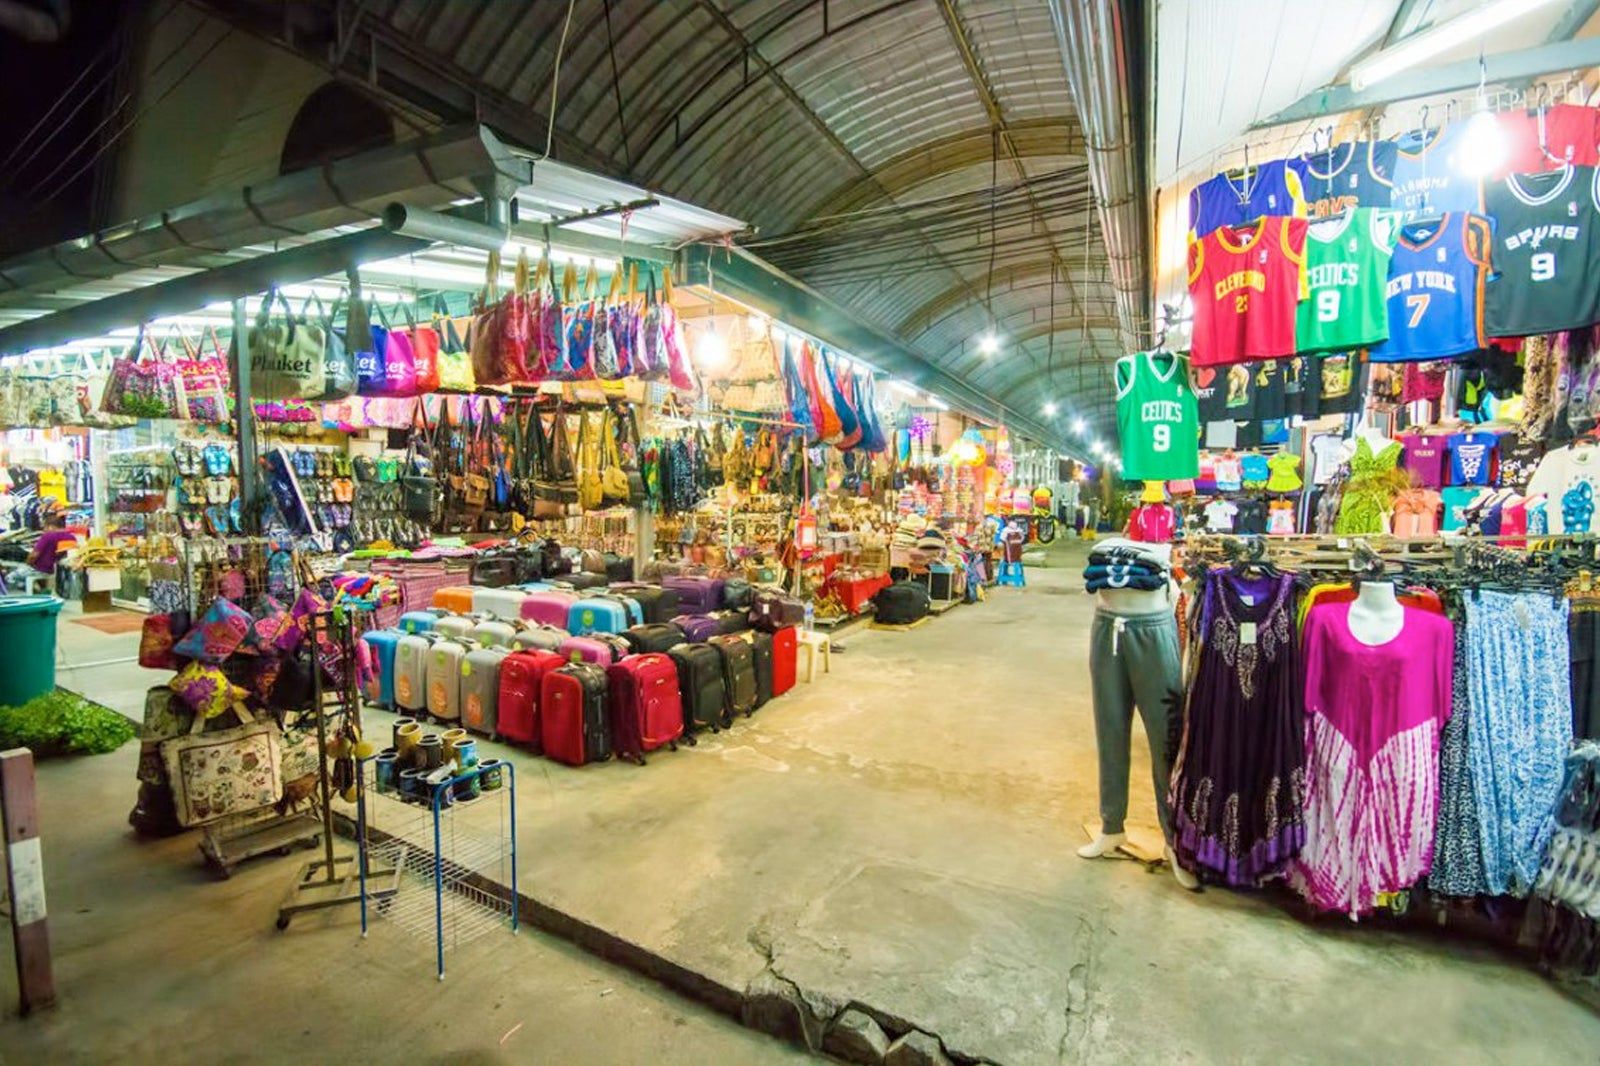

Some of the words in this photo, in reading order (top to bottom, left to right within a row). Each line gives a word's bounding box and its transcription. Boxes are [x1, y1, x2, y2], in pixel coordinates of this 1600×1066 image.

[1505, 225, 1579, 250] SPURS
[1531, 252, 1555, 281] 9
[1416, 271, 1456, 294] YORK
[1317, 289, 1340, 322] 9
[1406, 294, 1430, 328] 7
[1141, 400, 1182, 423] CELTICS
[1153, 424, 1170, 452] 9
